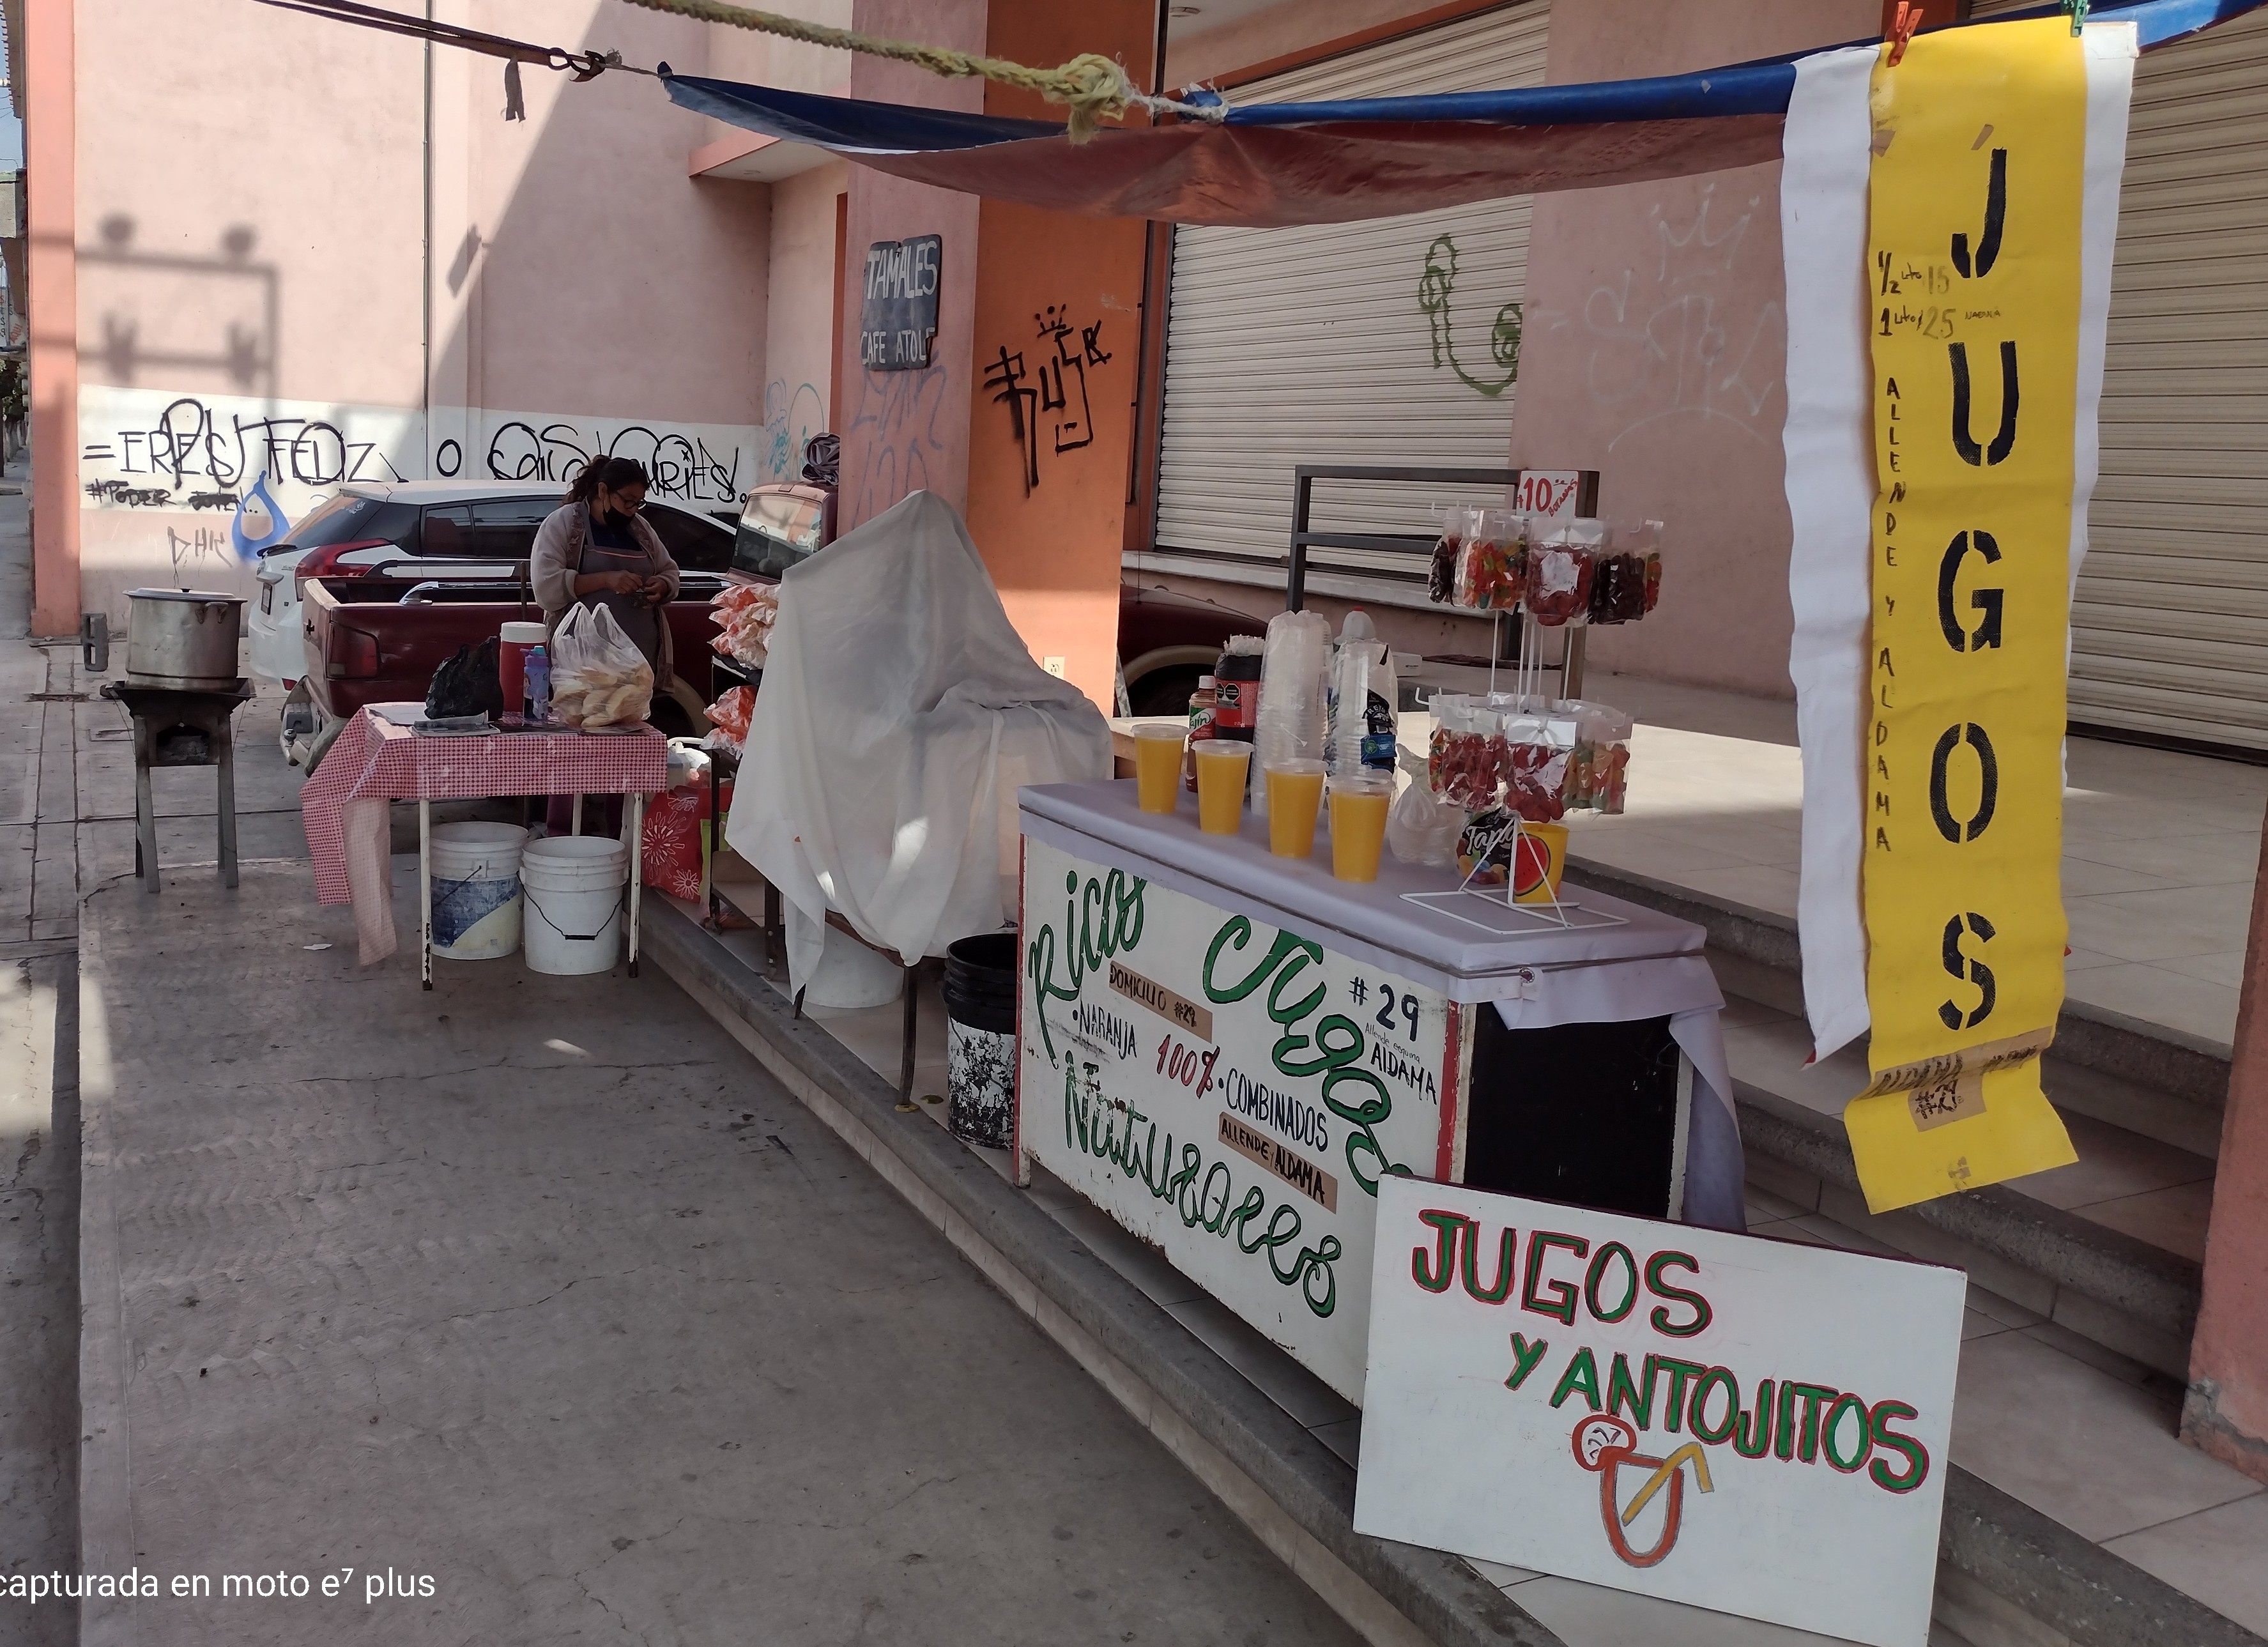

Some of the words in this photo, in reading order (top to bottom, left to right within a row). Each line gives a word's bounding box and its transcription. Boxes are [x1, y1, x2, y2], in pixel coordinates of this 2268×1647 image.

[867, 241, 937, 300] TAMALES
[1928, 266, 1950, 295] 15
[861, 331, 887, 365] CAFE
[1878, 307, 1892, 336] 1
[1922, 306, 1956, 339] 25
[1929, 148, 2019, 1030] JUGOS
[1028, 868, 1147, 1069] Ricos
[1156, 1034, 1221, 1099] 100%
[1221, 1118, 1270, 1161] ALLENDE
[1225, 1068, 1329, 1153] COMBINADOS
[1411, 1208, 1714, 1338] JUGOS
[1503, 1331, 1549, 1391] Y
[1549, 1345, 1930, 1494] ANTOJITOS
